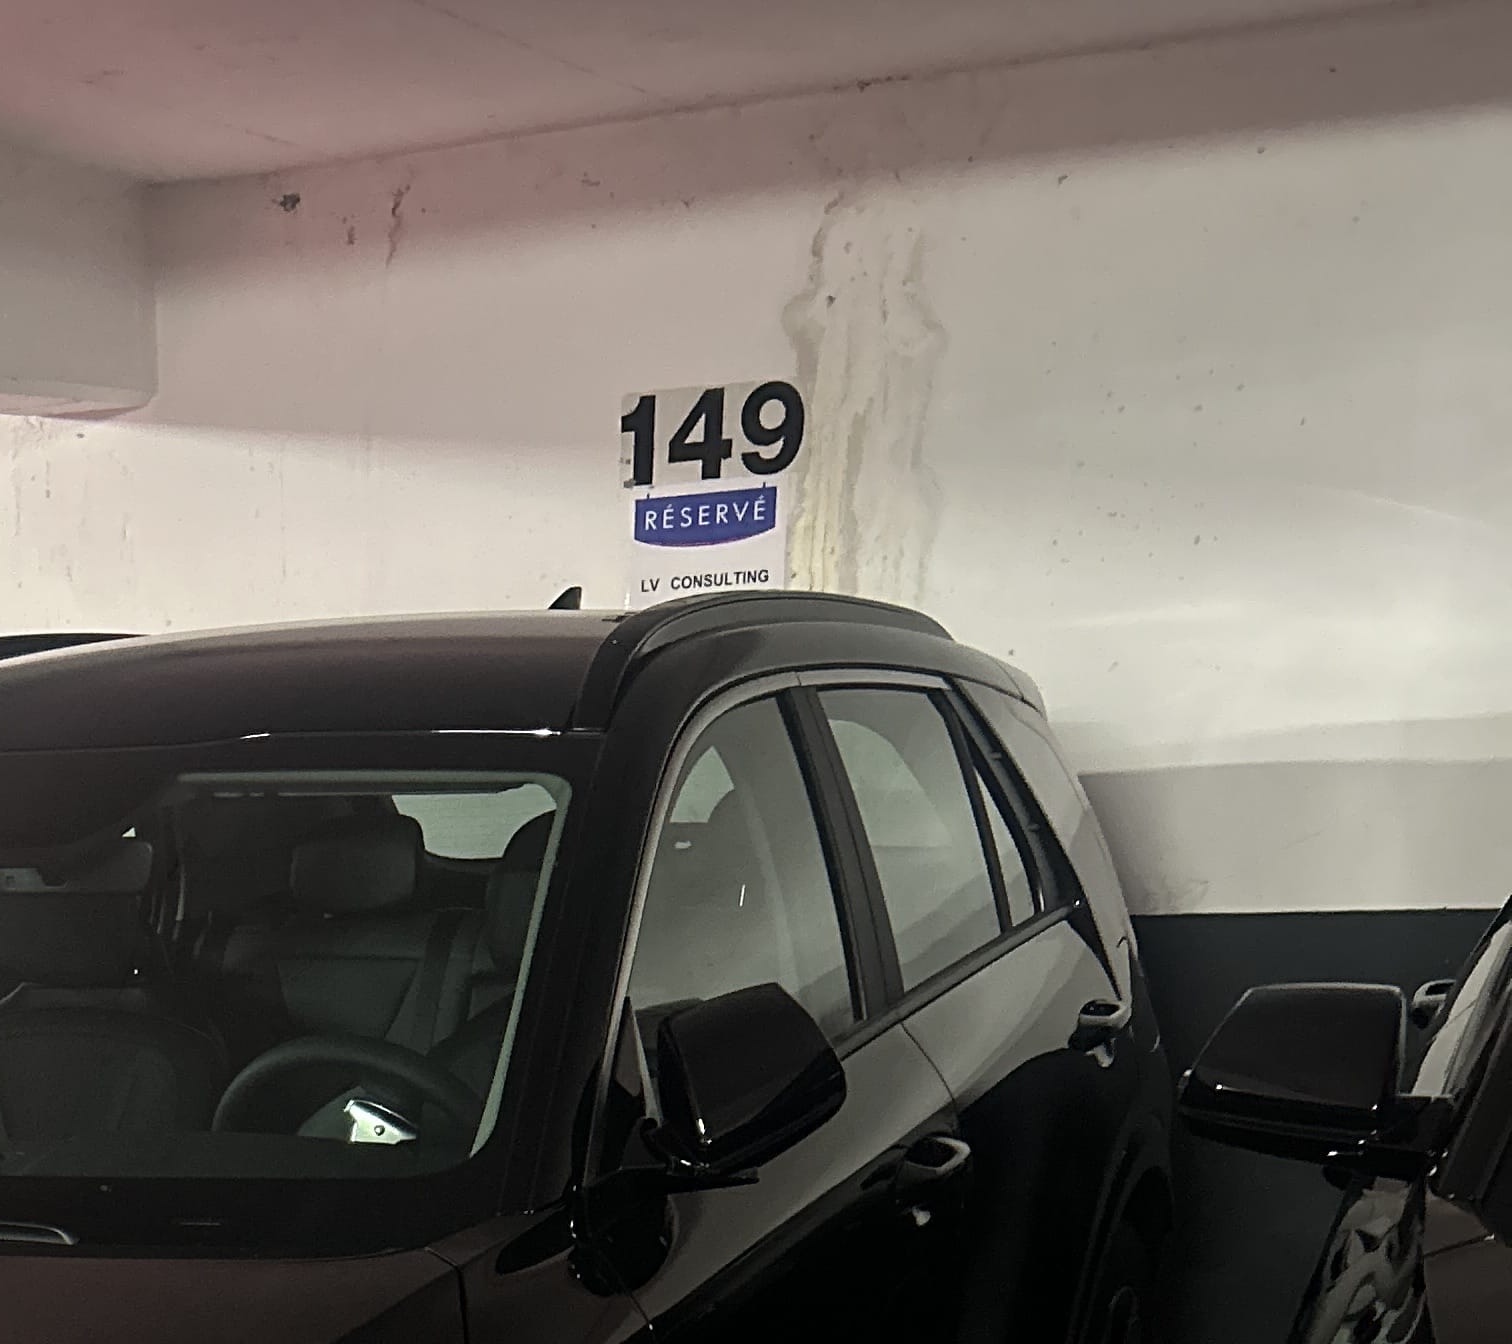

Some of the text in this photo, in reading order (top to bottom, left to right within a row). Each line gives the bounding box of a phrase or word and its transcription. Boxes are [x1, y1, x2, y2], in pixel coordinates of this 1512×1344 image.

[621, 381, 805, 486] 149
[645, 495, 766, 531] RÉSERVÉ
[641, 569, 769, 592] LV CONSULTING
